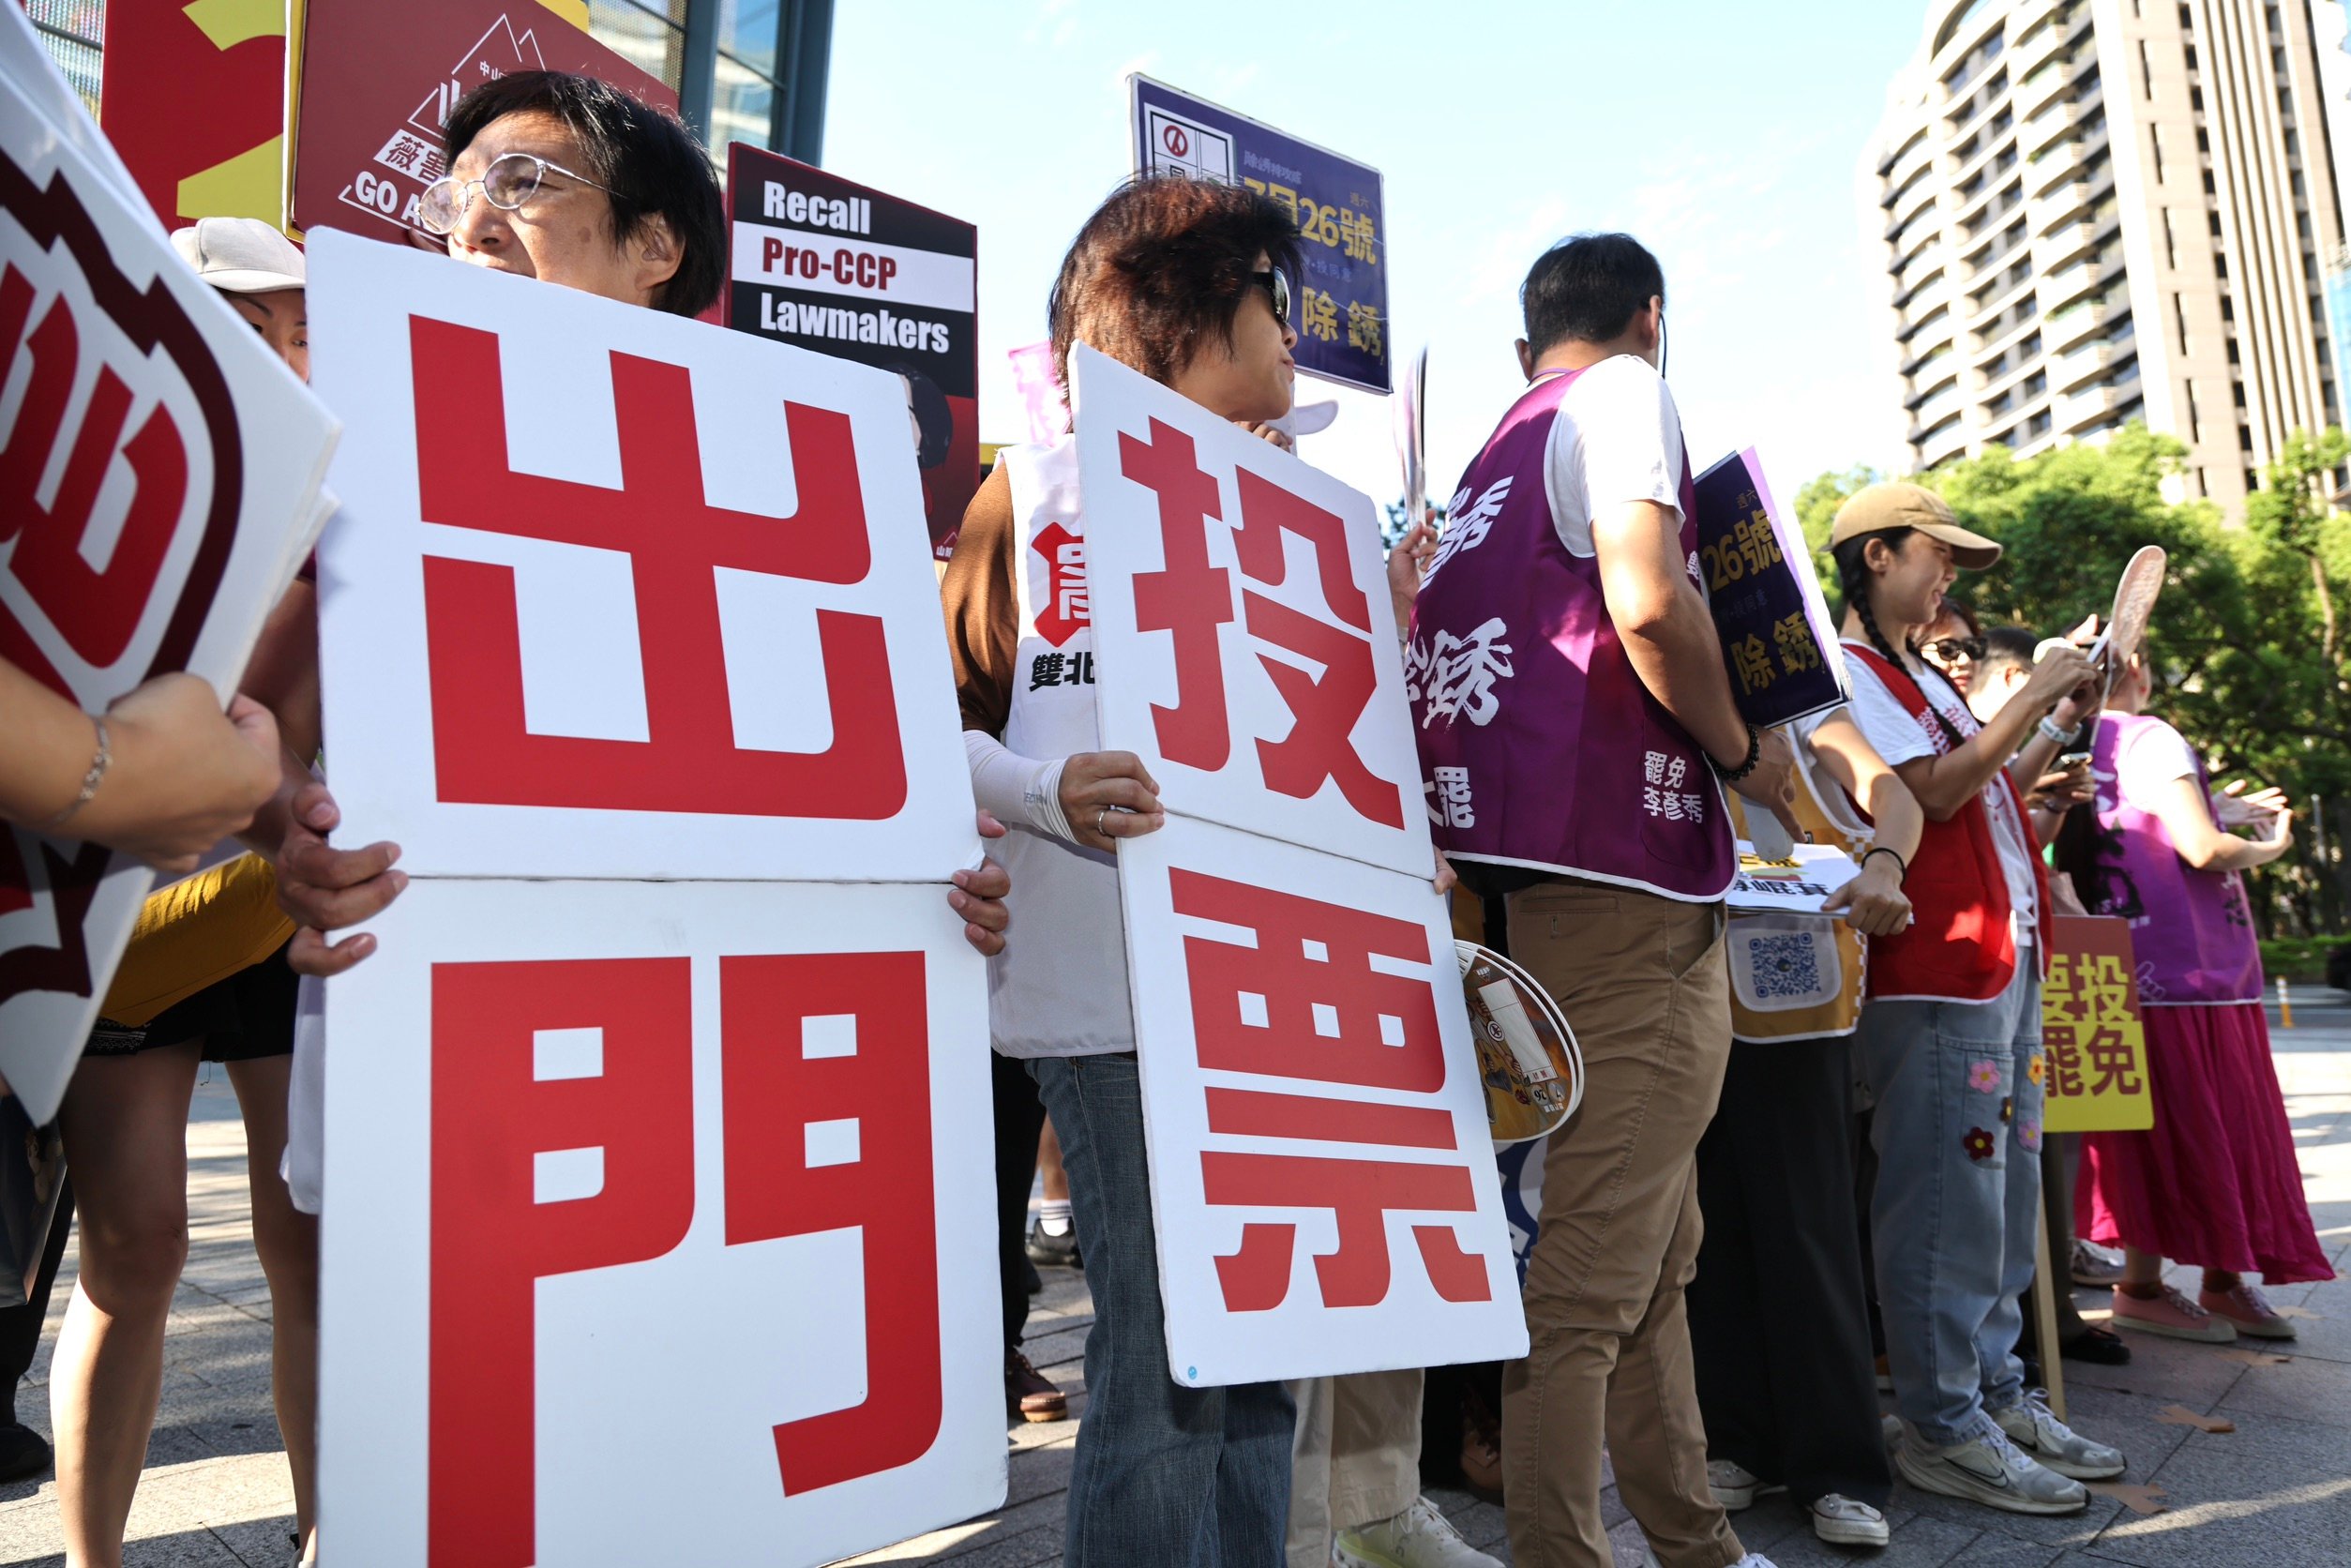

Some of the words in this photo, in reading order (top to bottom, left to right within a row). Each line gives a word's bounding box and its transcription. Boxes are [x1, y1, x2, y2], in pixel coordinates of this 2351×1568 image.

[355, 171, 398, 214] GO
[763, 180, 870, 235] Recall
[762, 236, 897, 291] Pro-CCP
[760, 293, 949, 354] Lawmakers
[1029, 652, 1095, 692] 雙北
[1644, 750, 1686, 788] 罷免
[1643, 786, 1703, 823] 李彥秀
[1118, 415, 1493, 1313] 投票
[2042, 1025, 2142, 1097] 罷免
